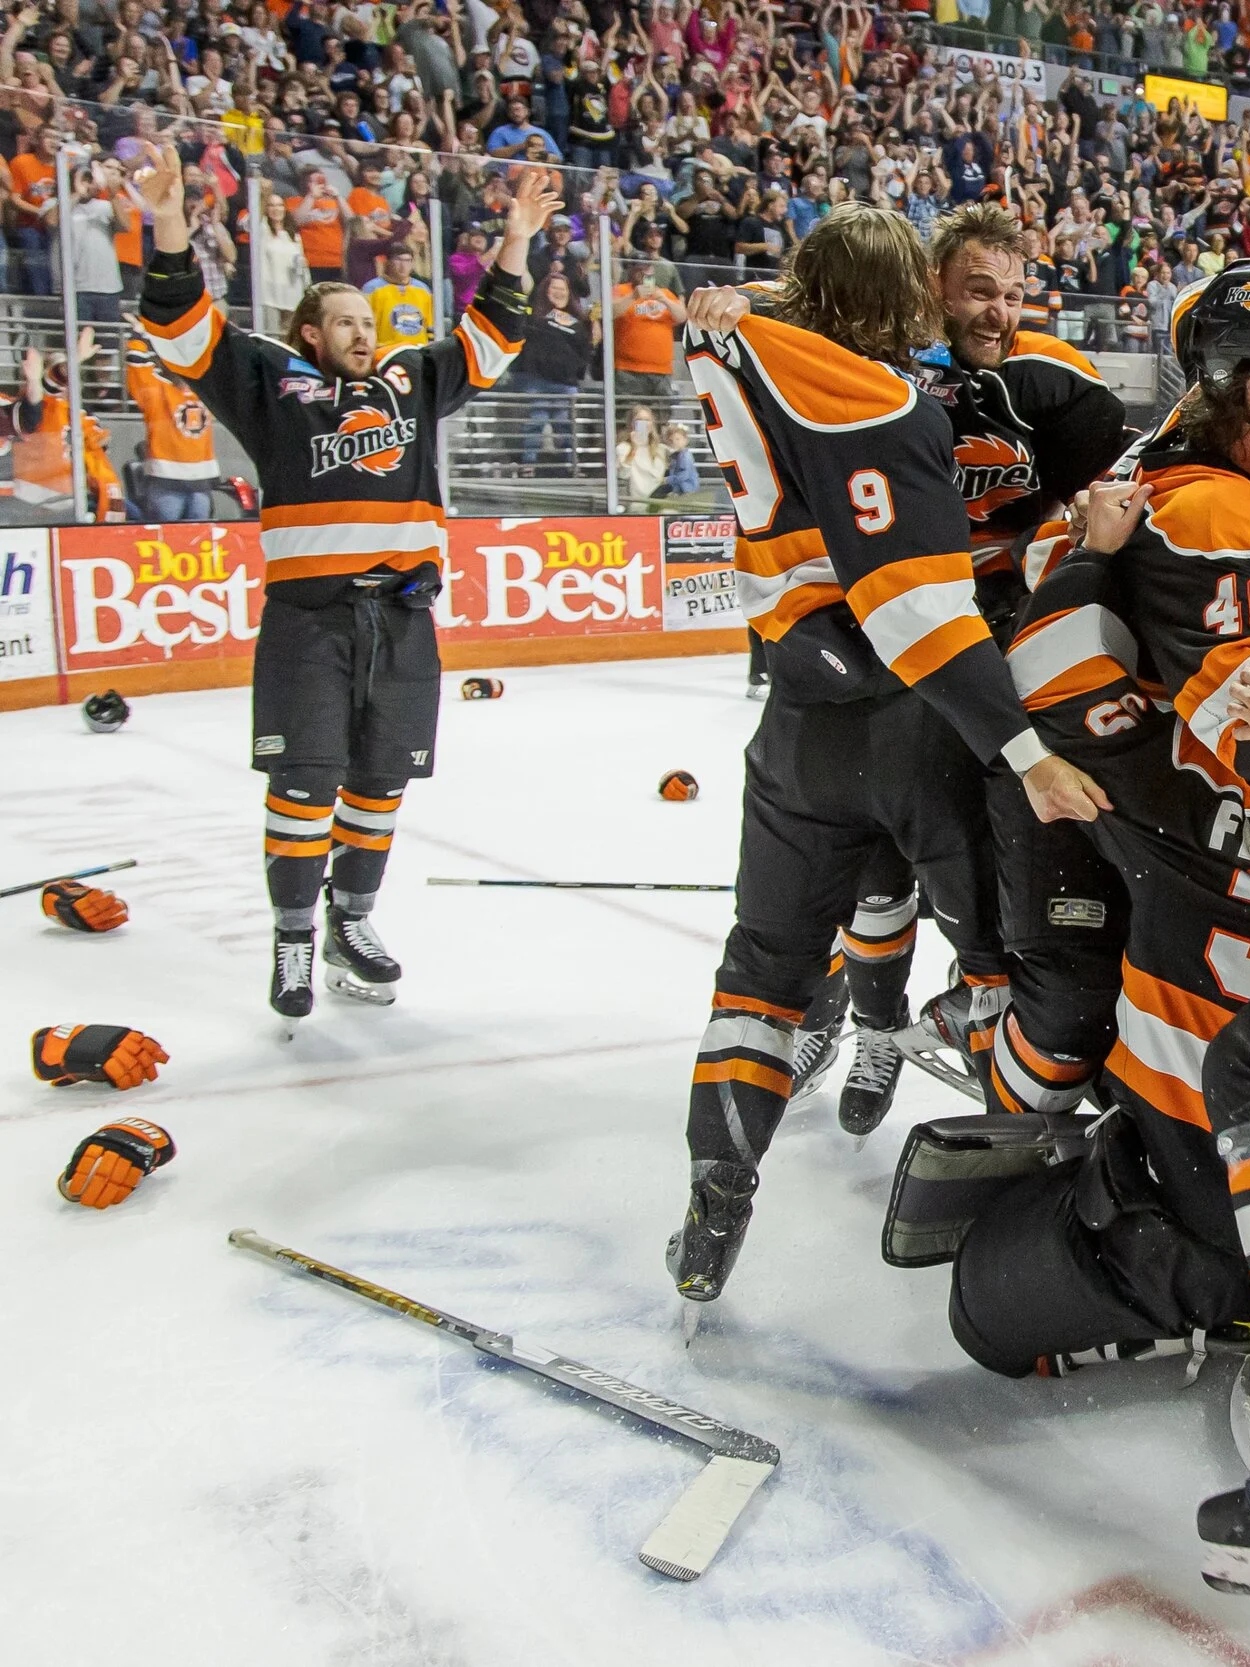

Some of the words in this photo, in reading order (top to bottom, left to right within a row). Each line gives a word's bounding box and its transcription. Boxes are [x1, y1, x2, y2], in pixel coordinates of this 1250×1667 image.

[928, 386, 950, 398] CUP
[311, 417, 417, 478] Komets
[667, 521, 738, 538] GLENB
[847, 468, 896, 535] 9
[61, 557, 261, 655] Best
[475, 545, 655, 627] Best
